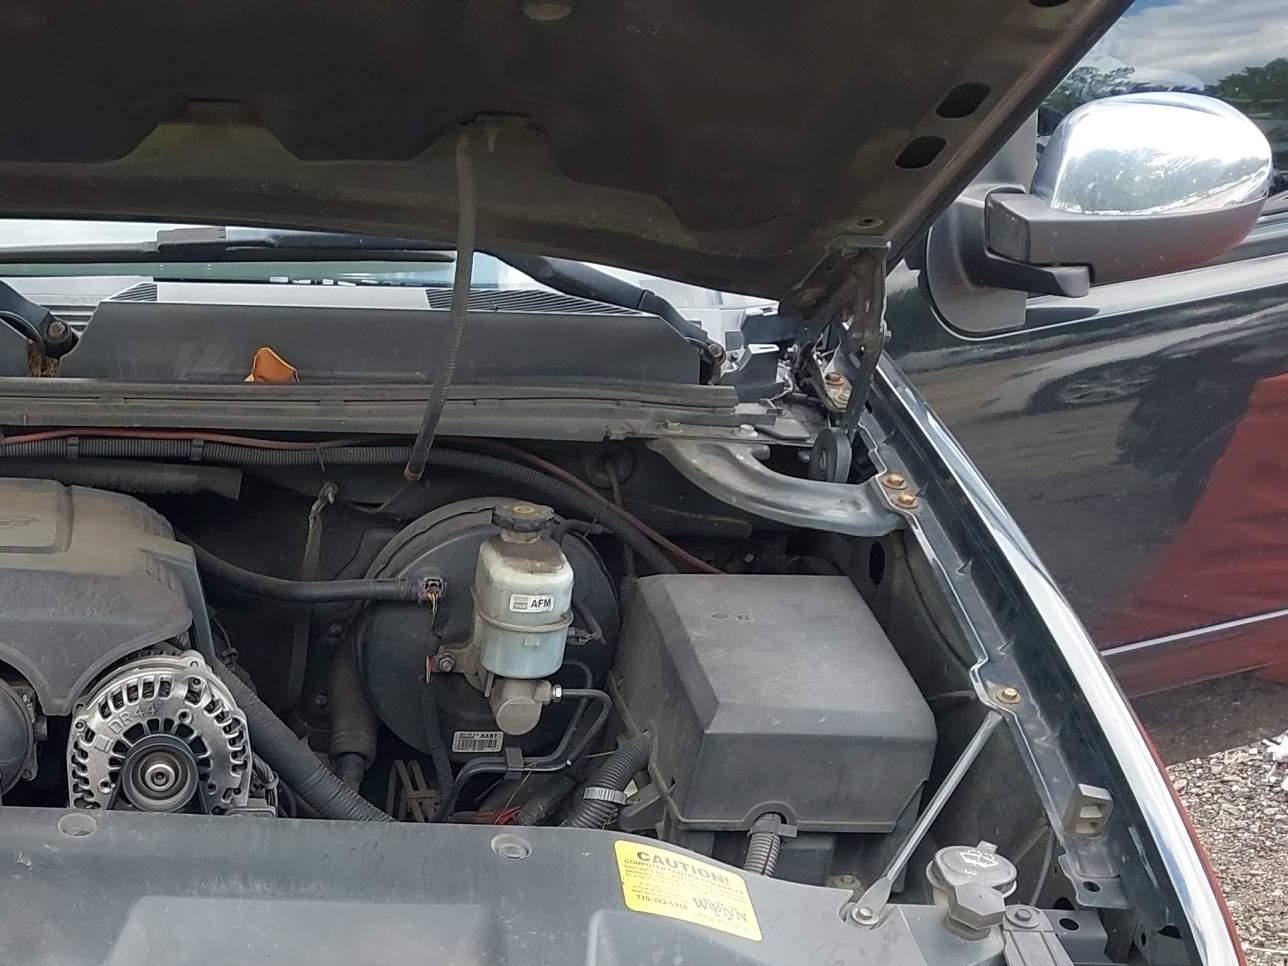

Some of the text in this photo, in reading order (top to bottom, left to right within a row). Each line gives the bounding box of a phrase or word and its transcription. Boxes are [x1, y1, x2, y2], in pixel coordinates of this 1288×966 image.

[530, 598, 552, 608] AFM
[109, 703, 157, 734] DR44
[637, 851, 730, 886] CAUTION!
